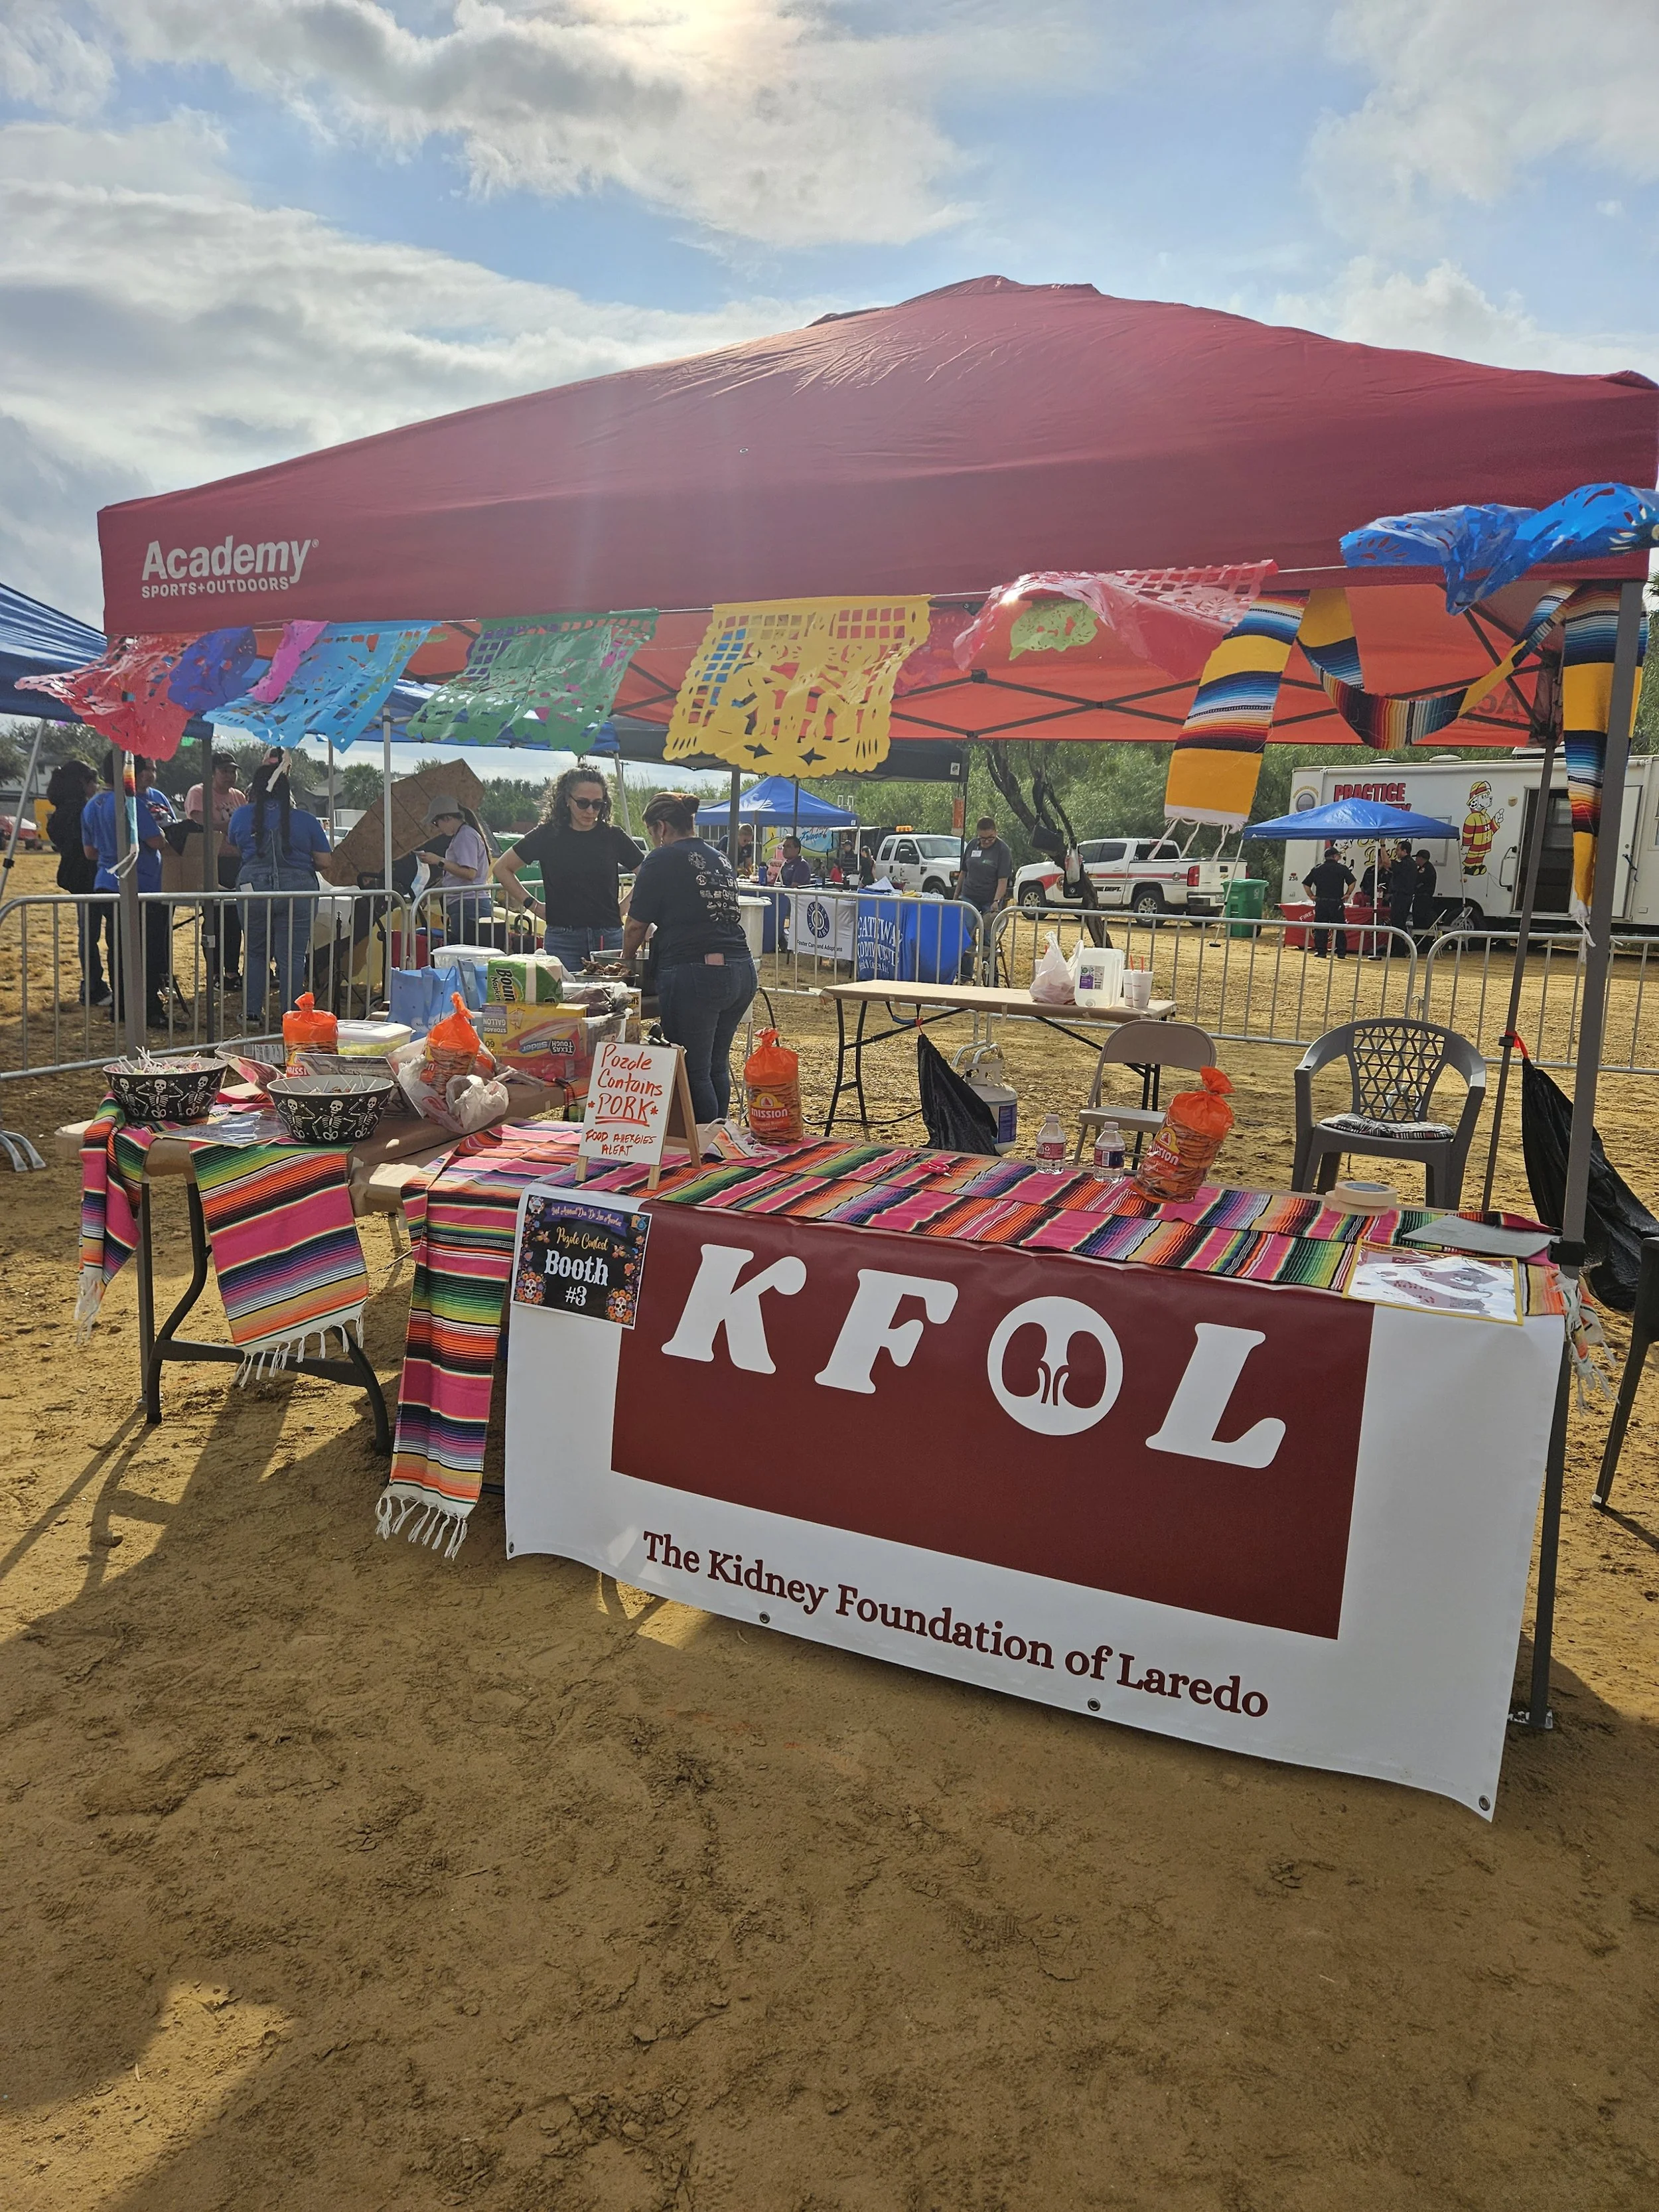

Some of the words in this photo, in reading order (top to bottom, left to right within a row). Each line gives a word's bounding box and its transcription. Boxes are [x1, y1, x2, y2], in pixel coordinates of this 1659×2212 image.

[141, 535, 311, 584] Academy
[141, 576, 289, 599] SPORTS+OUTDOORS
[1333, 782, 1406, 802] PRACTICE
[808, 903, 828, 919] CIRLES
[1299, 911, 1313, 921] FIRE
[816, 926, 829, 937] ARE
[490, 976, 502, 1001] Napkin
[495, 968, 516, 1001] Boun
[601, 1043, 652, 1070] Pozole
[597, 1069, 663, 1097] Contains
[585, 1129, 609, 1142] FOOD
[601, 1143, 633, 1156] ALERT
[556, 1226, 580, 1249] Pozole
[581, 1232, 609, 1250] Contest
[543, 1248, 609, 1286] Booth
[565, 1286, 587, 1306] #3
[643, 1530, 700, 1573] The
[707, 1548, 830, 1615] Kidney
[835, 1583, 1055, 1670] Foundation
[1065, 1644, 1113, 1681] of
[1118, 1653, 1269, 1718] Laredo
